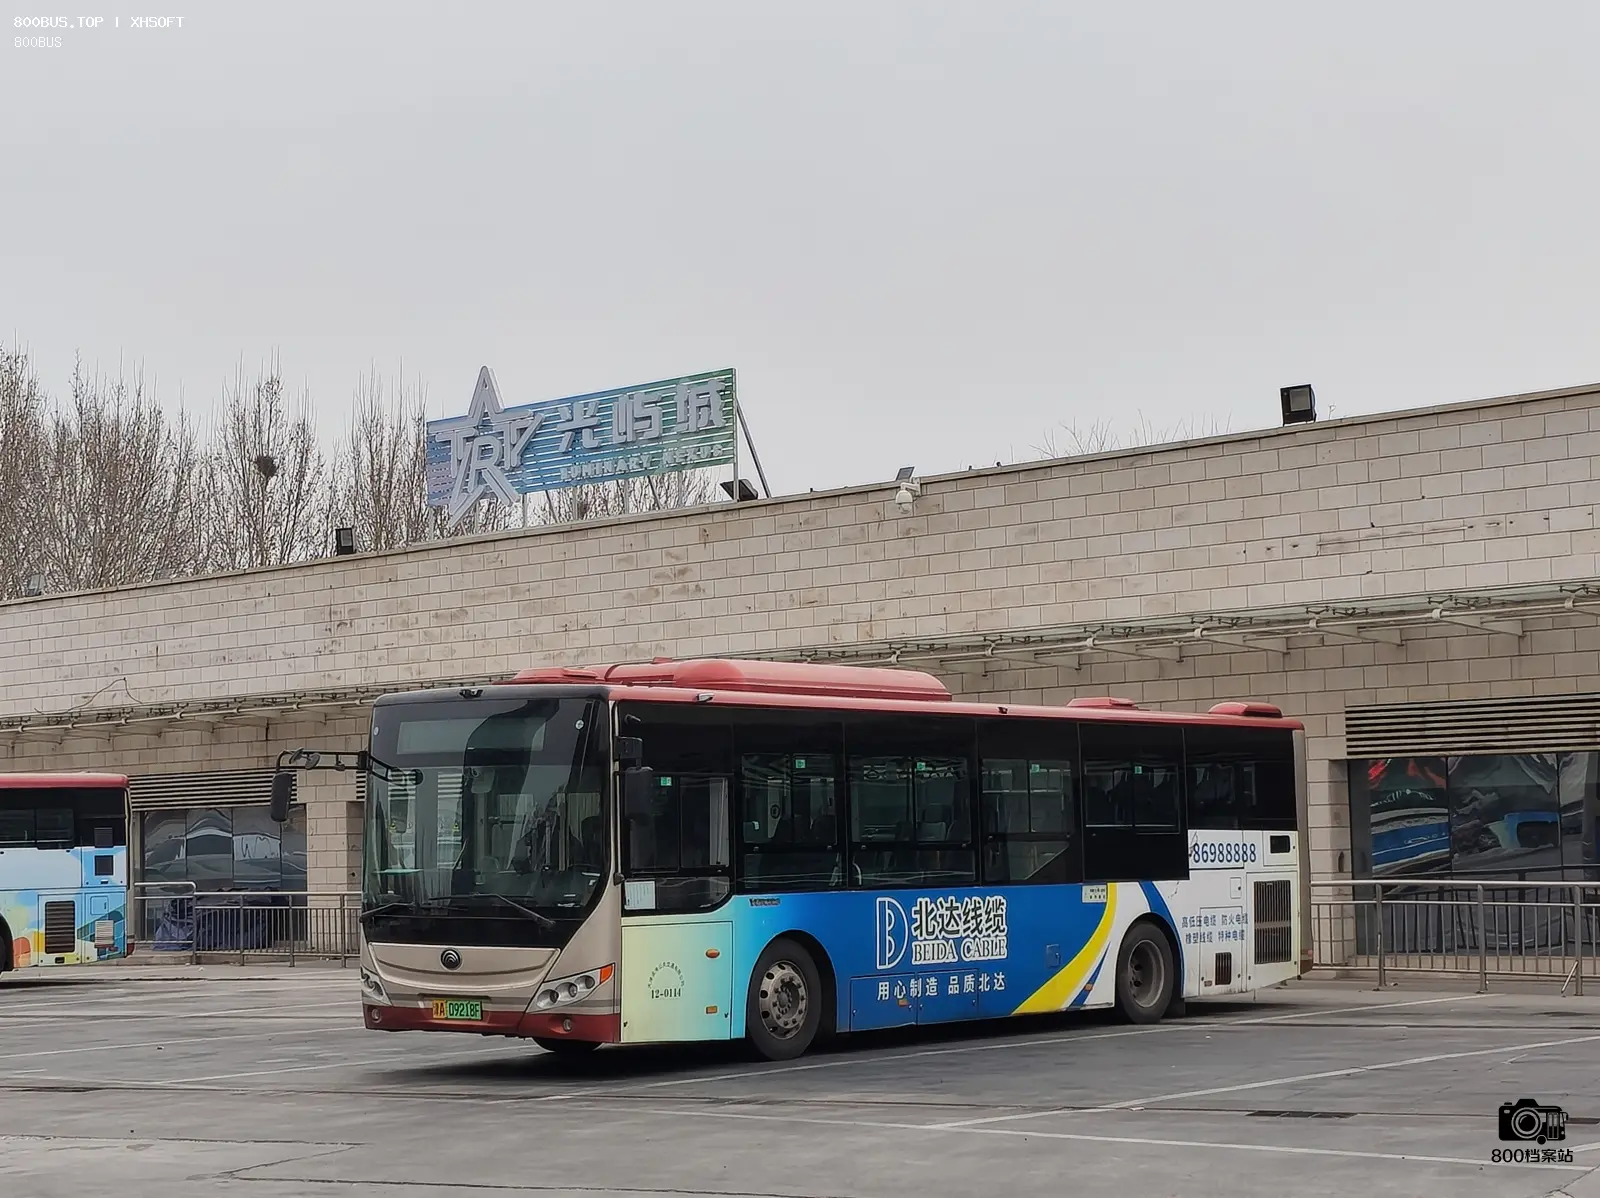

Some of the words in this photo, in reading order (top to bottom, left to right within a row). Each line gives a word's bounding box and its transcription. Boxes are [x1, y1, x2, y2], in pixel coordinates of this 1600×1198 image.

[560, 453, 652, 480] LUMINARY
[662, 444, 723, 465] NEXUS
[1193, 842, 1257, 863] 86988888
[911, 896, 1008, 940] 北达线缆
[912, 939, 958, 965] BEIDA
[961, 936, 1008, 962] CABLE
[877, 976, 938, 1001] 用心制造
[948, 972, 1006, 995] 品质北达
